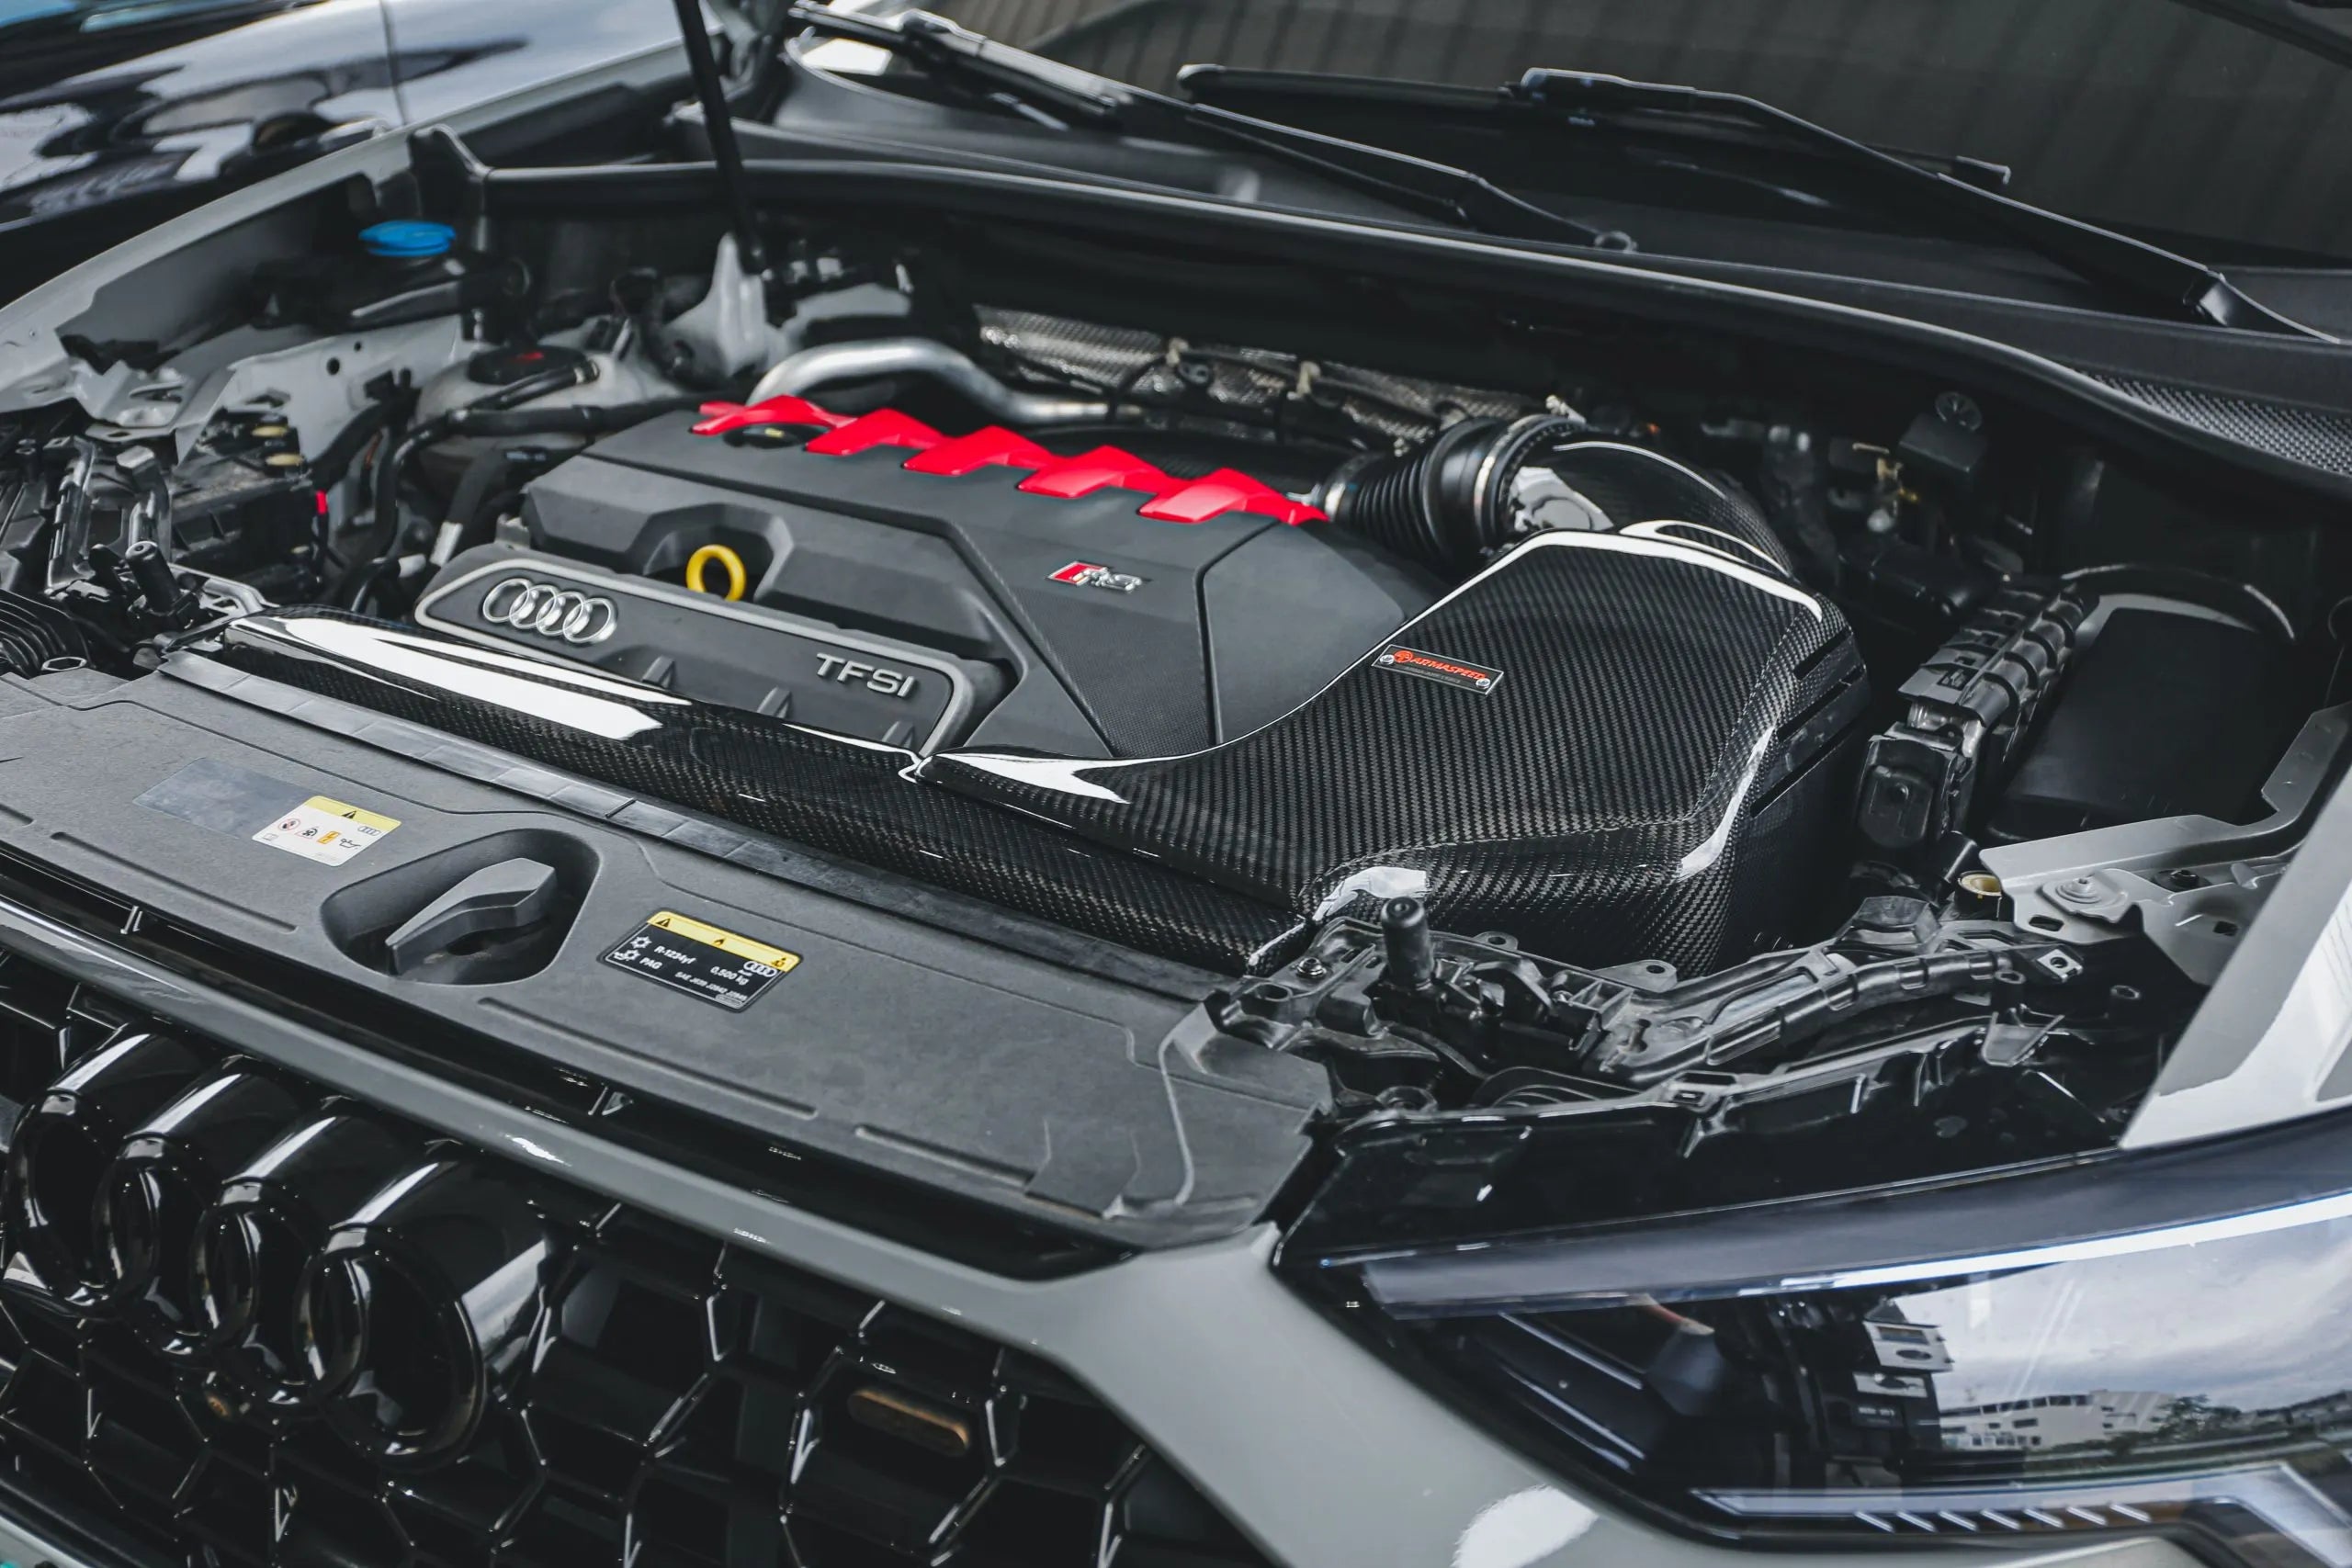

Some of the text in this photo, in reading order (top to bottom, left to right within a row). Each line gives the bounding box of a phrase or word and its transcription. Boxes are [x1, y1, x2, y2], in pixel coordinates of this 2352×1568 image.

[817, 652, 914, 697] TFSI
[1410, 656, 1487, 680] ARMASPEED
[639, 957, 663, 969] PAG
[653, 945, 696, 964] R-1234yf
[735, 975, 750, 986] kg
